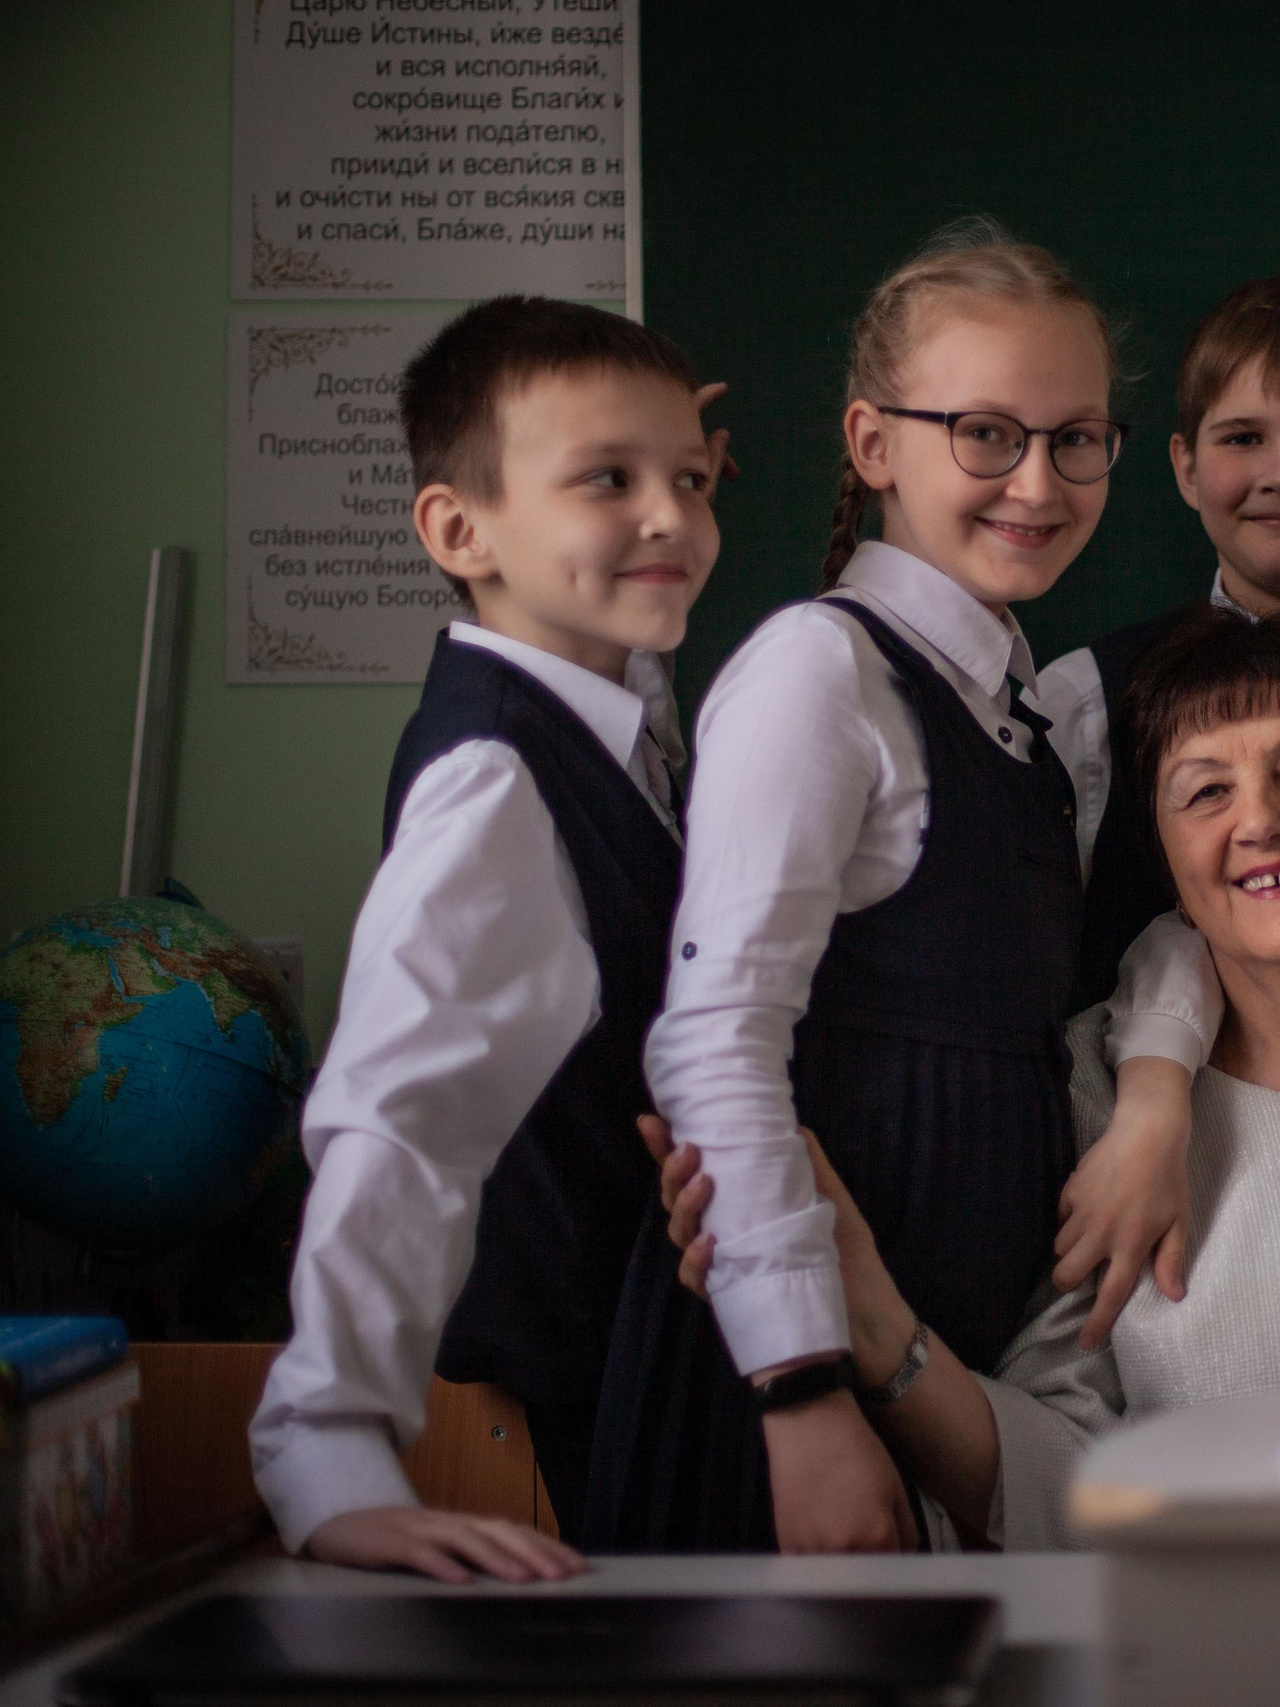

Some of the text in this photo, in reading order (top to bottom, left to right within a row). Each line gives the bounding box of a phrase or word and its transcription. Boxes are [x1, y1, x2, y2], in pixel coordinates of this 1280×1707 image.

[376, 59, 391, 76] и
[401, 59, 445, 76] вся
[439, 157, 454, 174] и
[582, 157, 595, 174] в
[276, 190, 291, 207] и
[401, 190, 438, 207] ны
[447, 190, 474, 207] от
[297, 223, 312, 240] и
[349, 467, 363, 484] и
[265, 554, 307, 576] без
